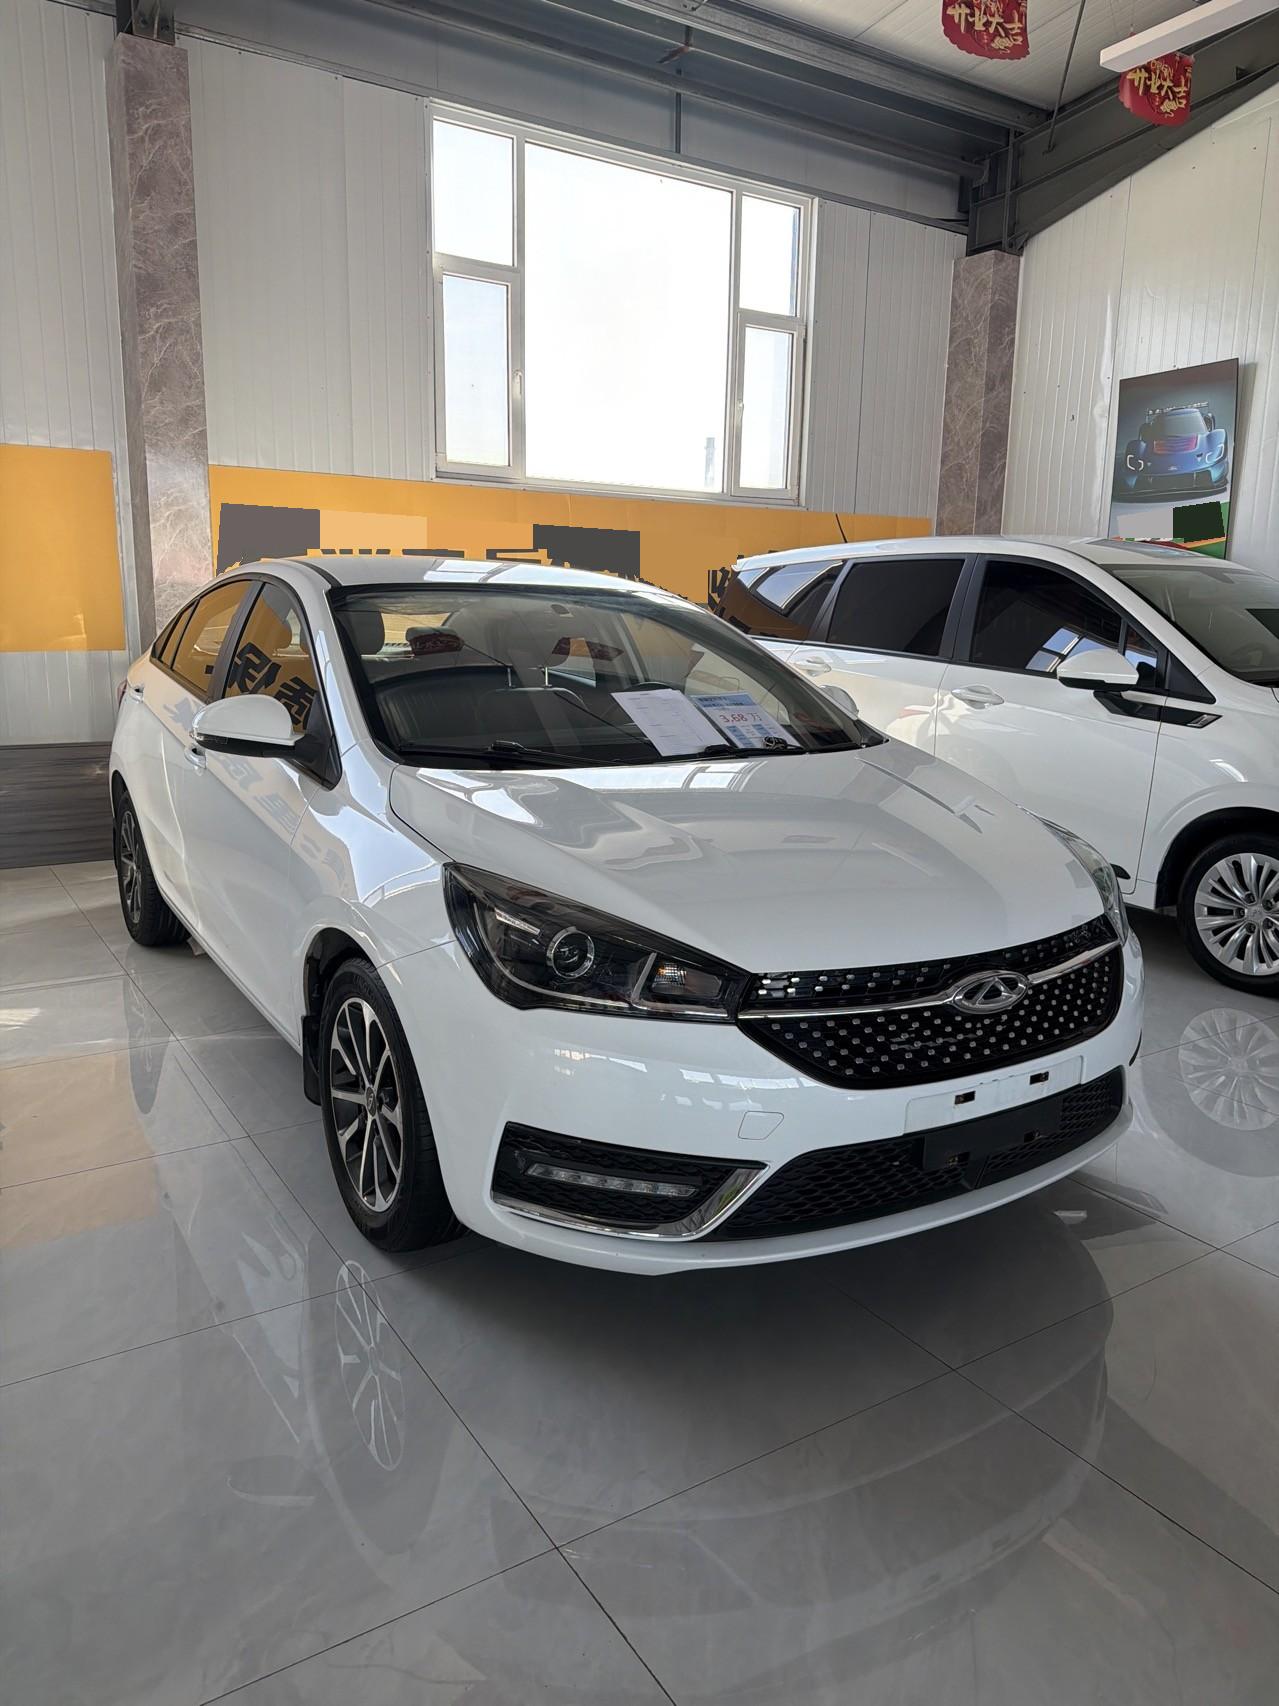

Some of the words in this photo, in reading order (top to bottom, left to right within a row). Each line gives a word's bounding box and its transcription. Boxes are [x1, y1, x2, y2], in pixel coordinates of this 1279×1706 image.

[946, 3, 1023, 45] 开业大吉
[1126, 67, 1188, 108] 开业大吉
